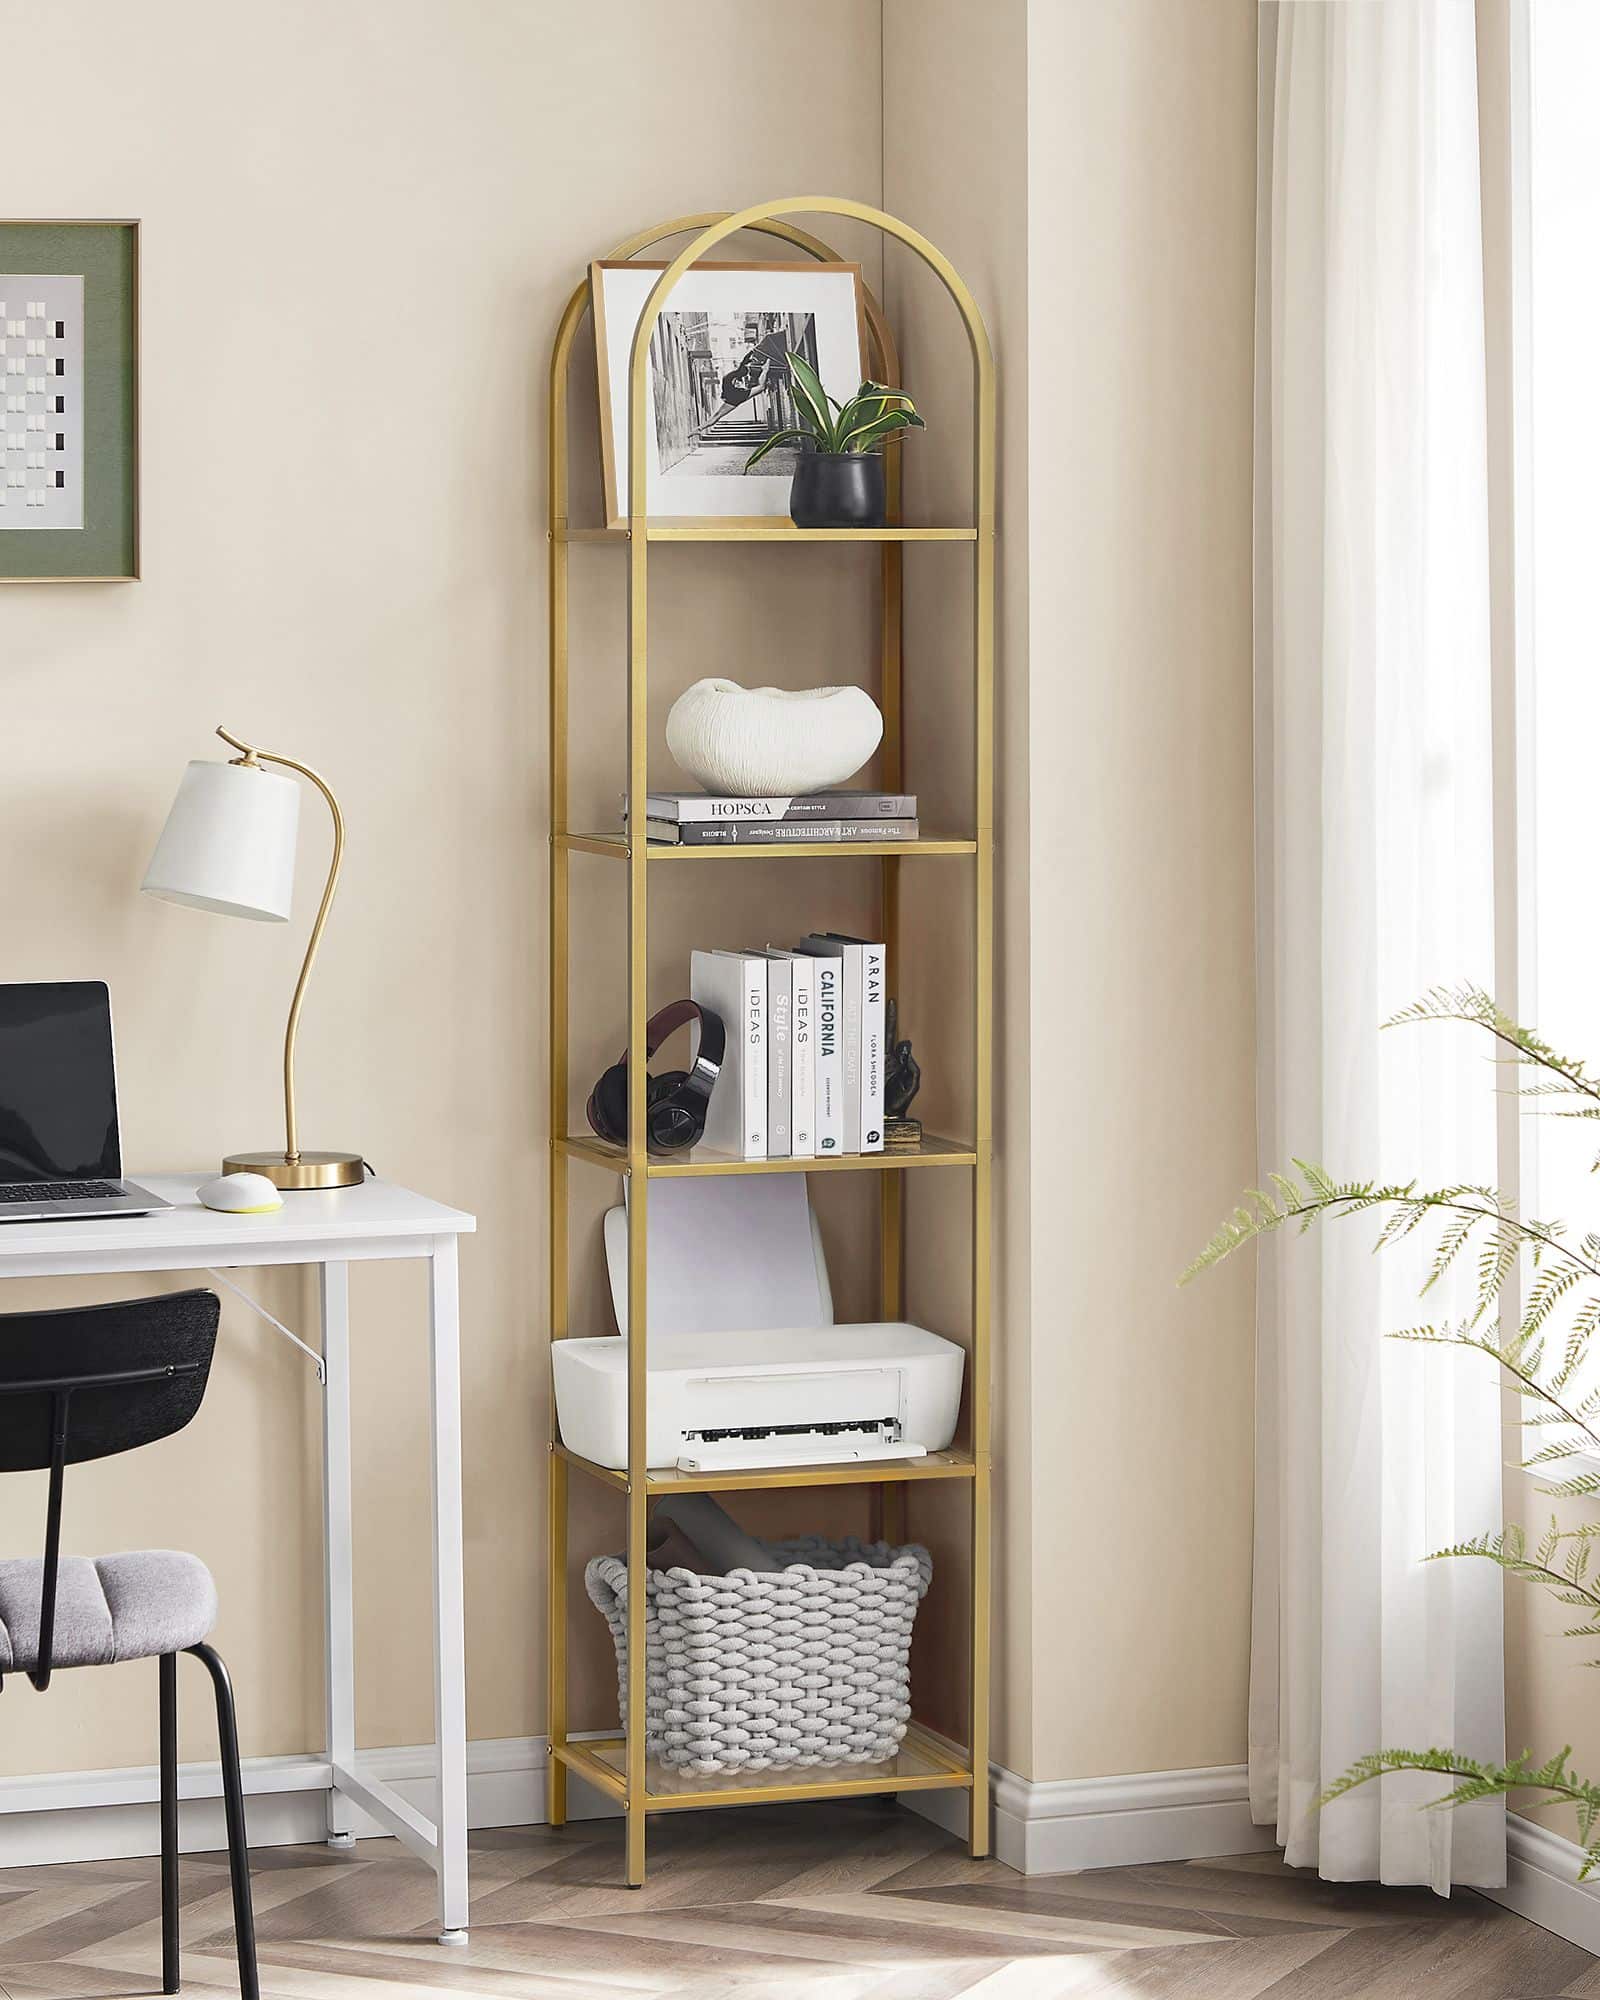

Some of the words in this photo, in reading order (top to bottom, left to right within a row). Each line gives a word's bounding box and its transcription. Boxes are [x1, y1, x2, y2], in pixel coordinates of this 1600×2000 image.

[711, 803, 771, 816] HOPSCA
[868, 955, 880, 1004] ARAN
[750, 989, 761, 1045] IDEAS
[775, 994, 789, 1042] Style
[797, 988, 808, 1043] IDEAS
[820, 970, 835, 1057] CALIFORNIA
